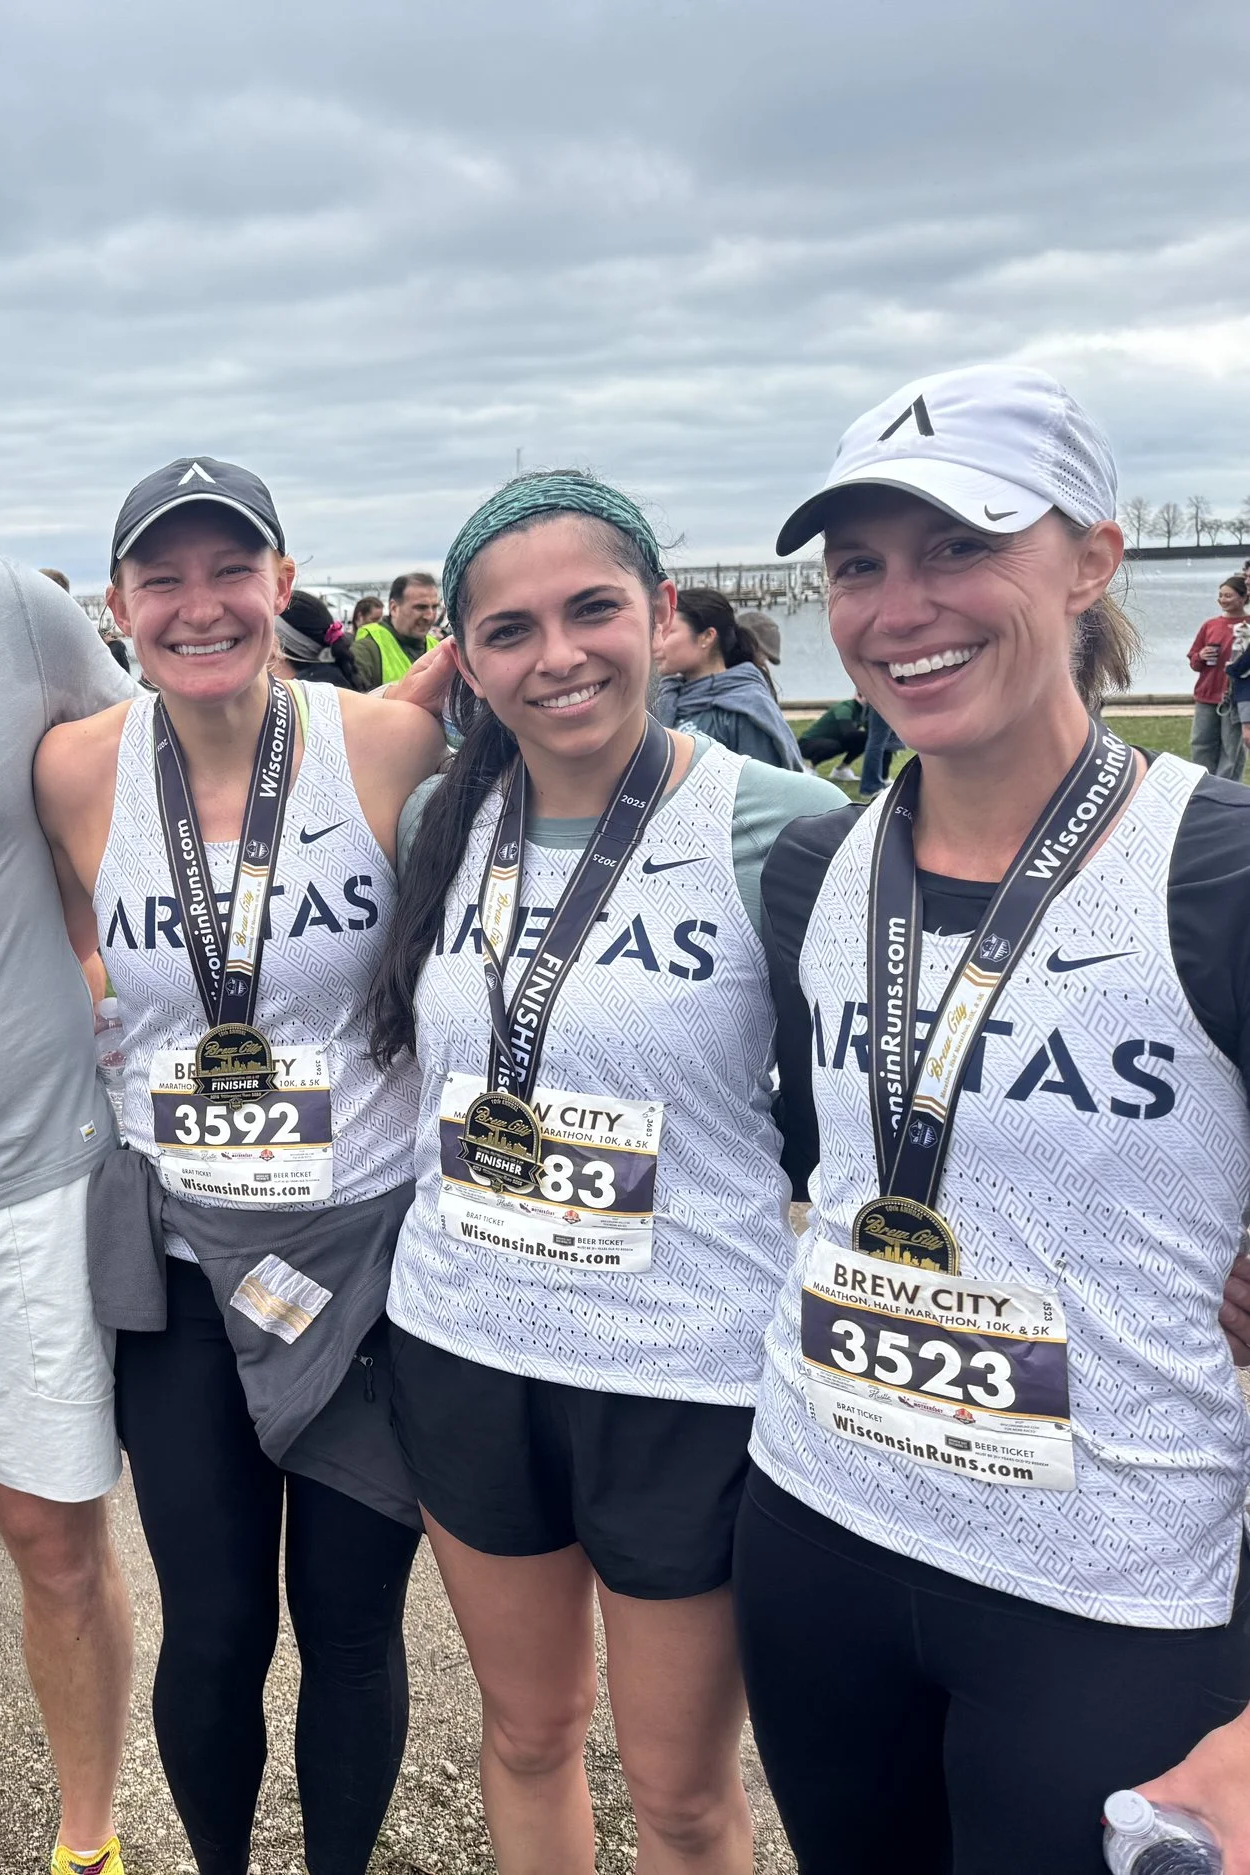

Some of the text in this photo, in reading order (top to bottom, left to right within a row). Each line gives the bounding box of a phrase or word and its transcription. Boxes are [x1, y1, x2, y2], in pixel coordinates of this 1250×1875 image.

[621, 794, 647, 809] 2025
[592, 853, 618, 868] 2025
[232, 914, 249, 948] Brew
[926, 1001, 968, 1083] Brew City
[211, 1079, 259, 1091] FINISHER
[309, 1078, 320, 1086] 5K
[174, 1101, 301, 1146] 3592
[560, 1106, 624, 1133] CITY
[599, 1134, 621, 1147] 10K,
[635, 1139, 649, 1149] 5K
[475, 1151, 523, 1176] FINISHER
[180, 1177, 311, 1197] WisconsinRuns.com
[465, 1211, 505, 1227] BRAT TICKET
[460, 1221, 621, 1266] WisconsinRuns.com
[577, 1237, 597, 1245] BEER
[598, 1238, 624, 1246] TICKET
[863, 1214, 945, 1251] Brew City
[833, 1263, 1011, 1318] BREW CITY
[812, 1282, 1050, 1336] MARATHON, HALF MARATHON, 10K, & 5K
[1043, 1301, 1053, 1322] 3523
[830, 1319, 1016, 1409] 3523
[836, 1402, 883, 1423] BRAT TICKET
[832, 1412, 1034, 1481] WisconsinRuns.com
[974, 1441, 998, 1453] BEER
[1001, 1446, 1035, 1459] TICKET
